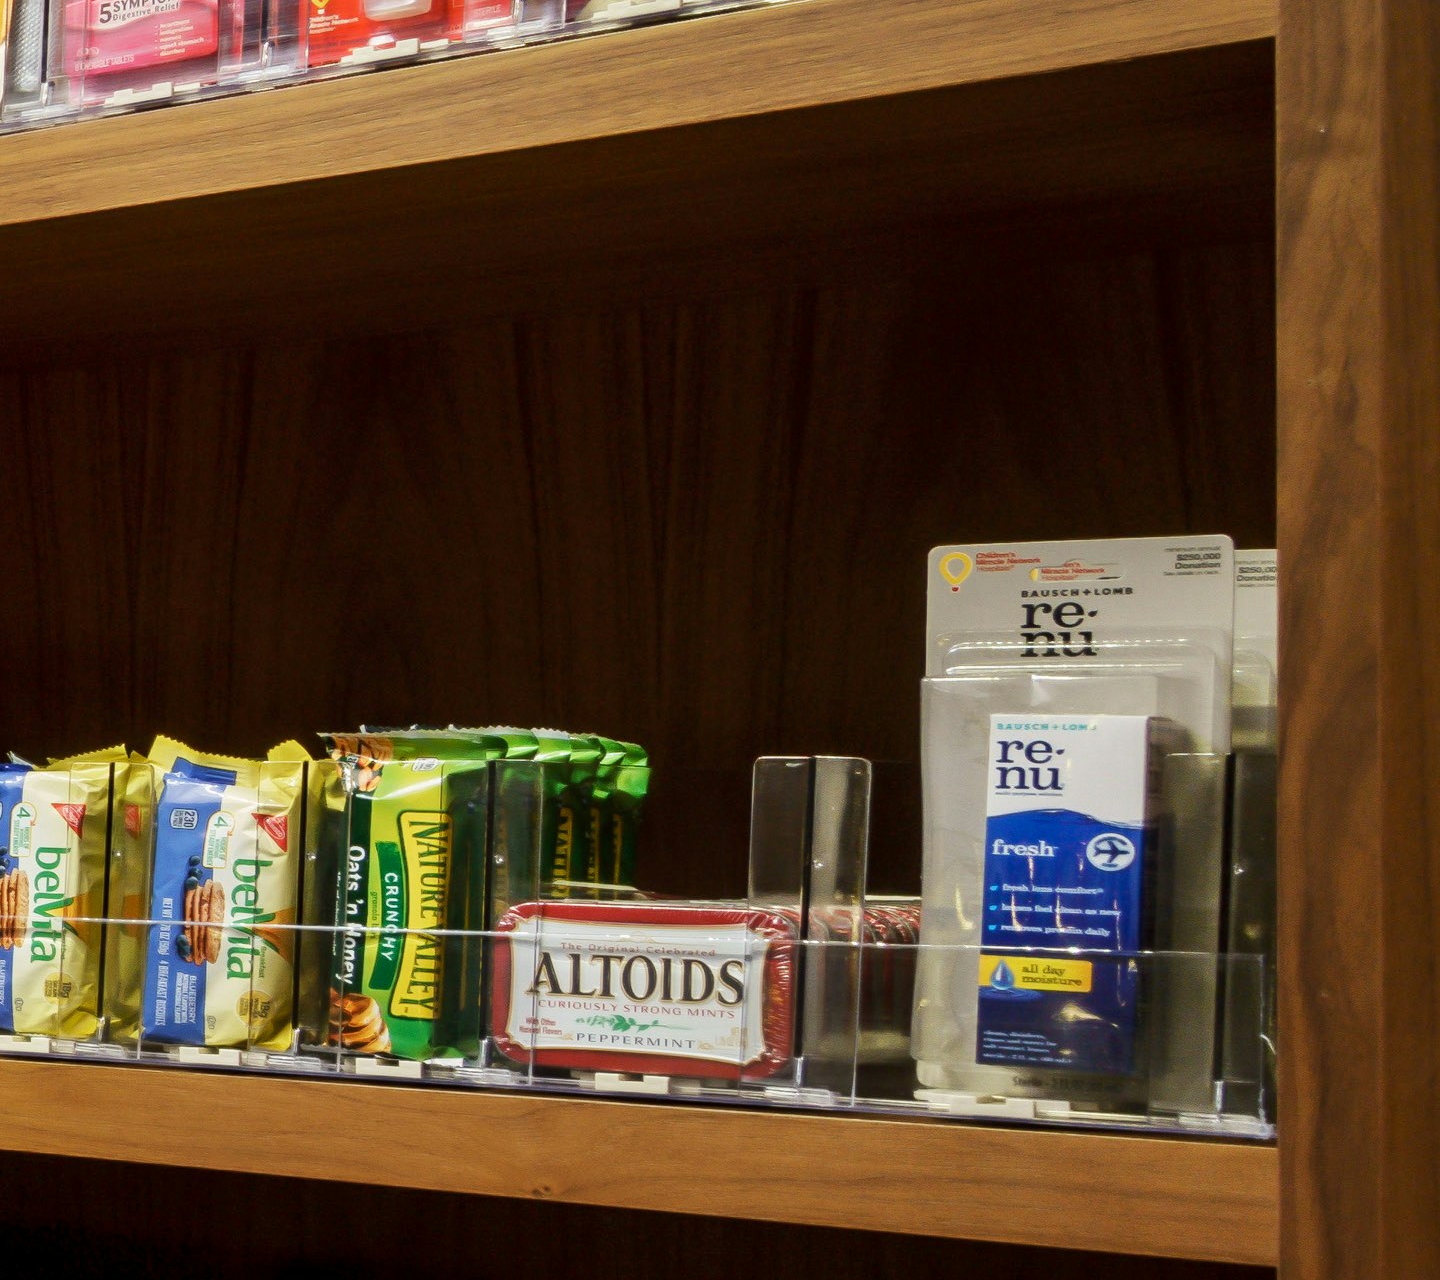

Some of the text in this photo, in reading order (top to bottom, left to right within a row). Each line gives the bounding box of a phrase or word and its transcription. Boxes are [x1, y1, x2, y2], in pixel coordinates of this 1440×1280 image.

[99, 3, 112, 24] 5
[1021, 589, 1079, 598] BAUSCH
[1020, 601, 1085, 629] re
[1020, 630, 1098, 657] nu
[995, 739, 1052, 763] re
[995, 766, 1063, 791] nu
[992, 839, 1054, 857] fresh
[348, 845, 366, 891] Oats
[383, 871, 397, 961] CRUNCHY
[405, 819, 450, 1015] NATURE VALLEY
[561, 943, 716, 957] The Original Celebrated
[526, 951, 746, 1007] ALTOIDS
[538, 999, 736, 1019] CURIOUSLY STRONG MINTS
[576, 1032, 696, 1050] PEPPERMINT
